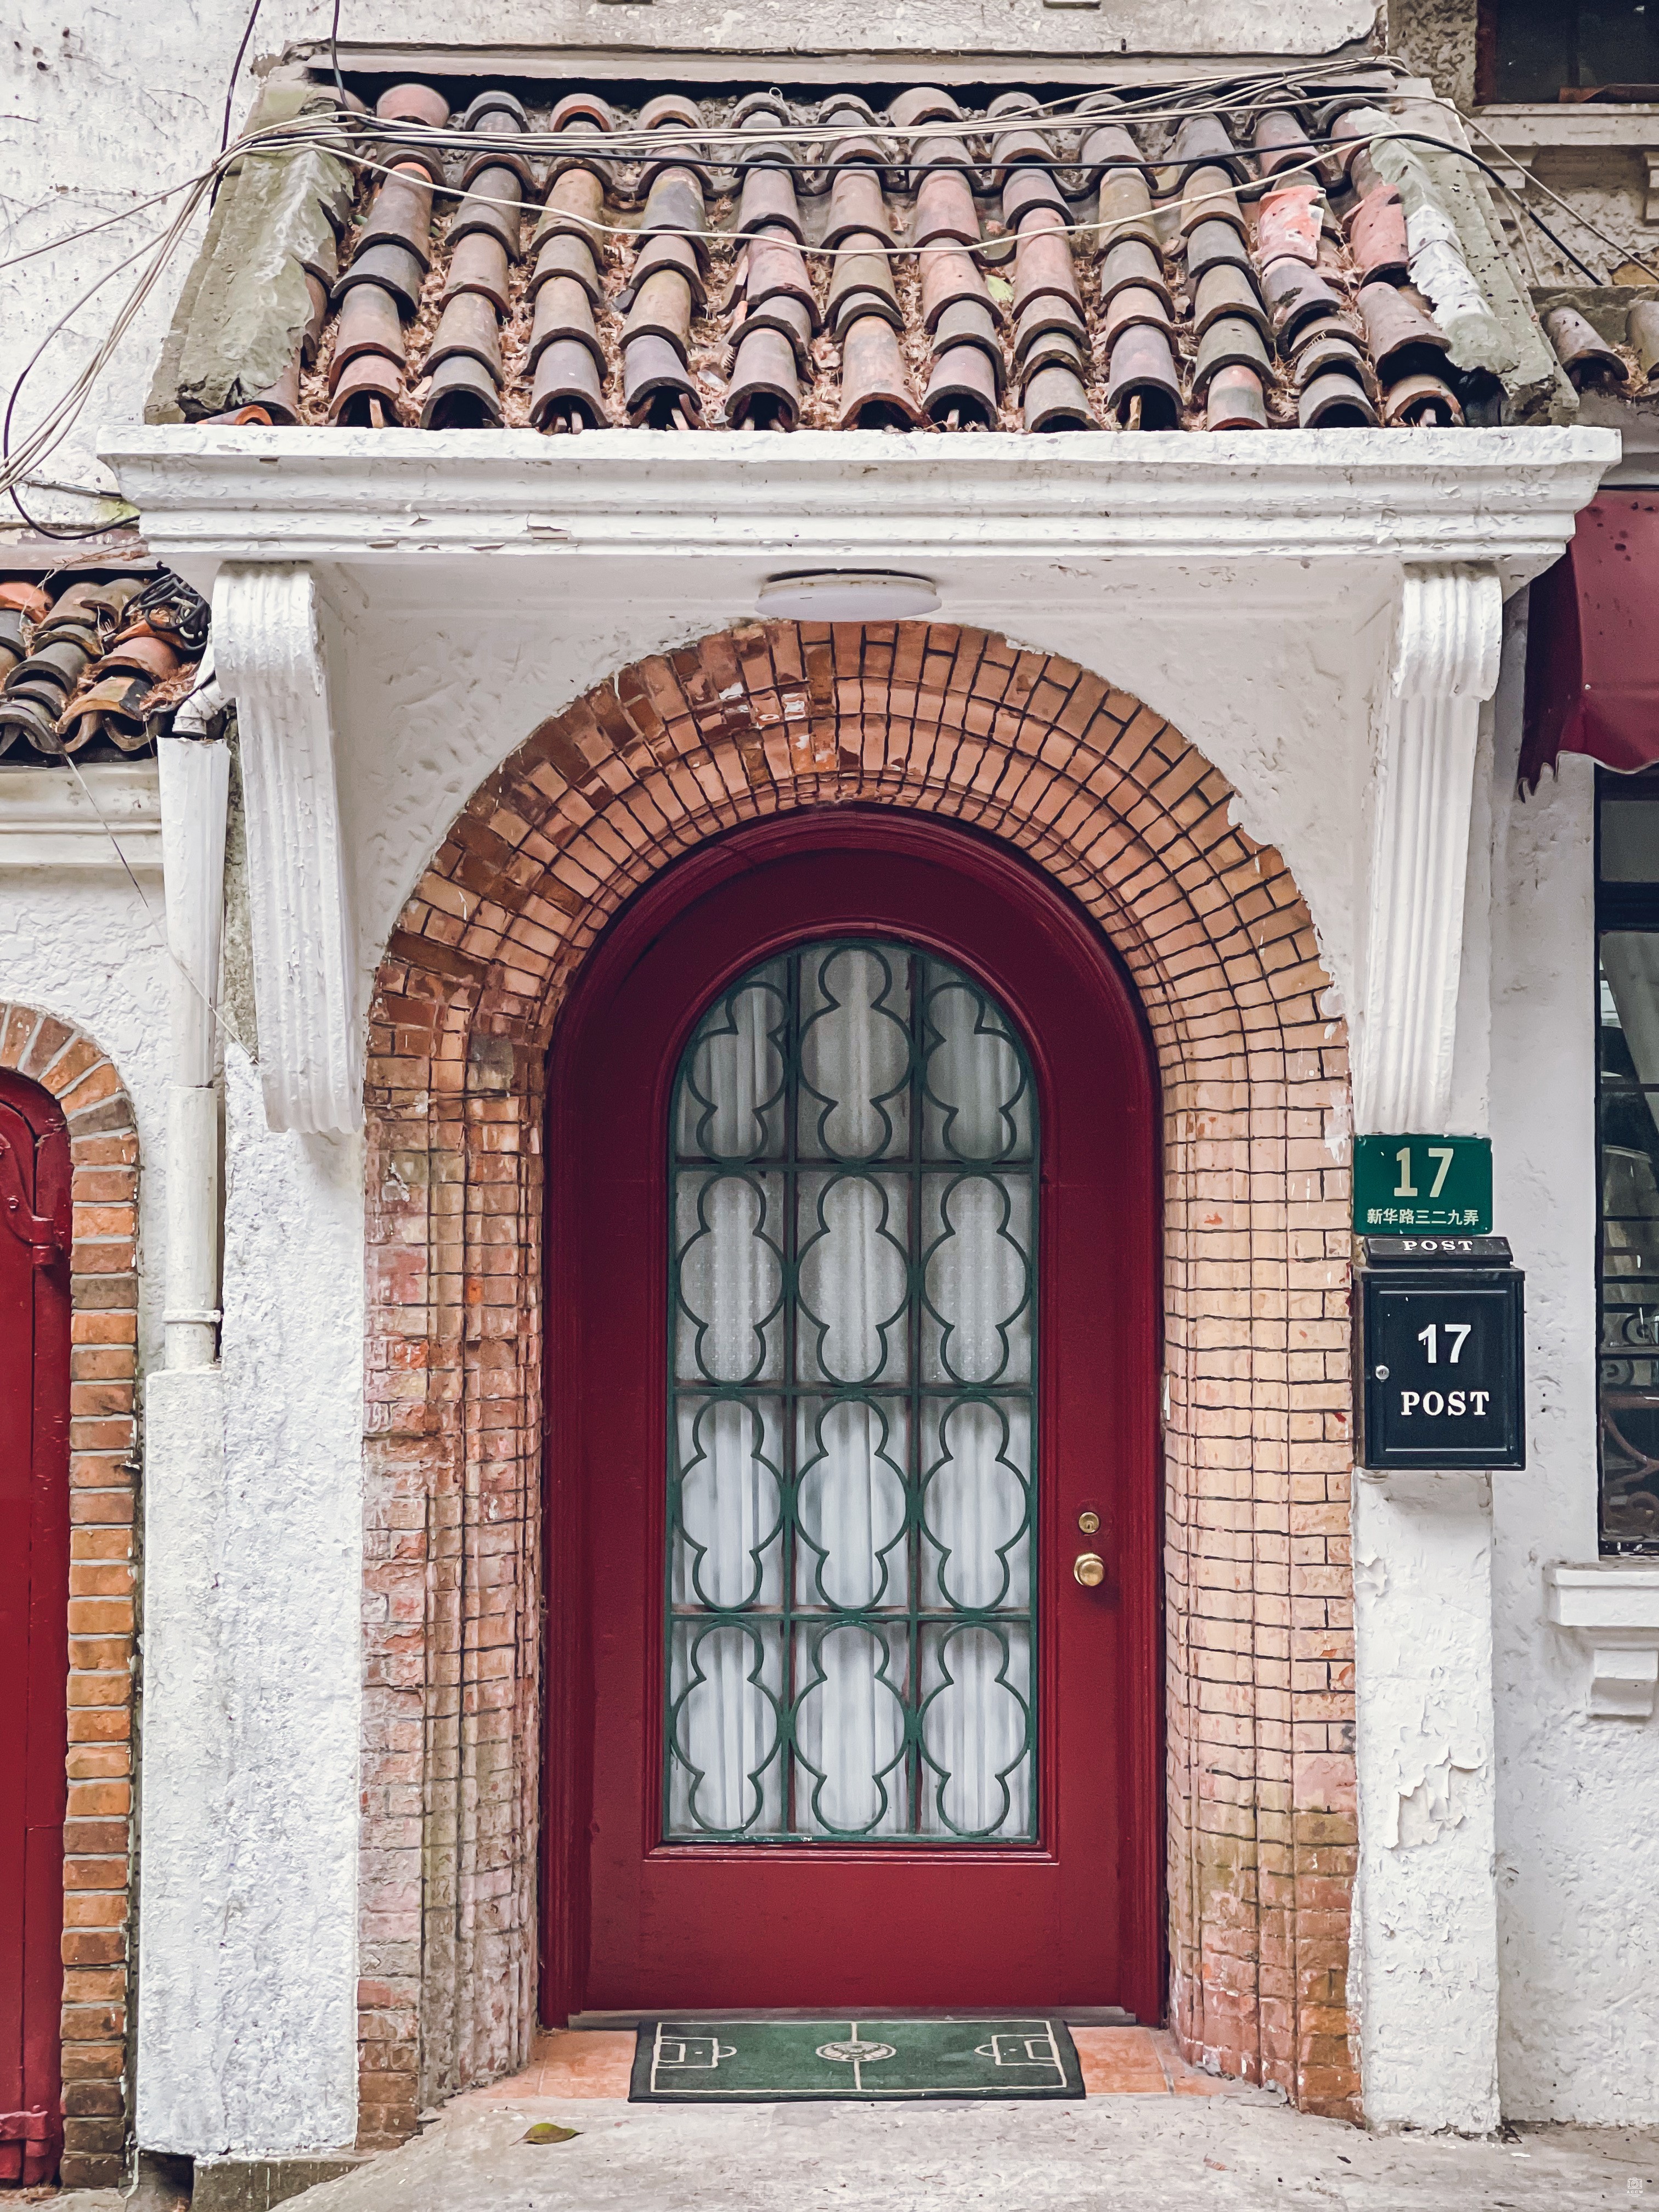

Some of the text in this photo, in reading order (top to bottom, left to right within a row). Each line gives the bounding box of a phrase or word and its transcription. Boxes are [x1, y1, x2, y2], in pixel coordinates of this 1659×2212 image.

[1393, 1147, 1454, 1198] 17
[1367, 1208, 1479, 1226] 新华路三二九弄
[1402, 1240, 1473, 1251] POST
[1418, 1324, 1471, 1363] 17
[1401, 1391, 1489, 1416] POST
